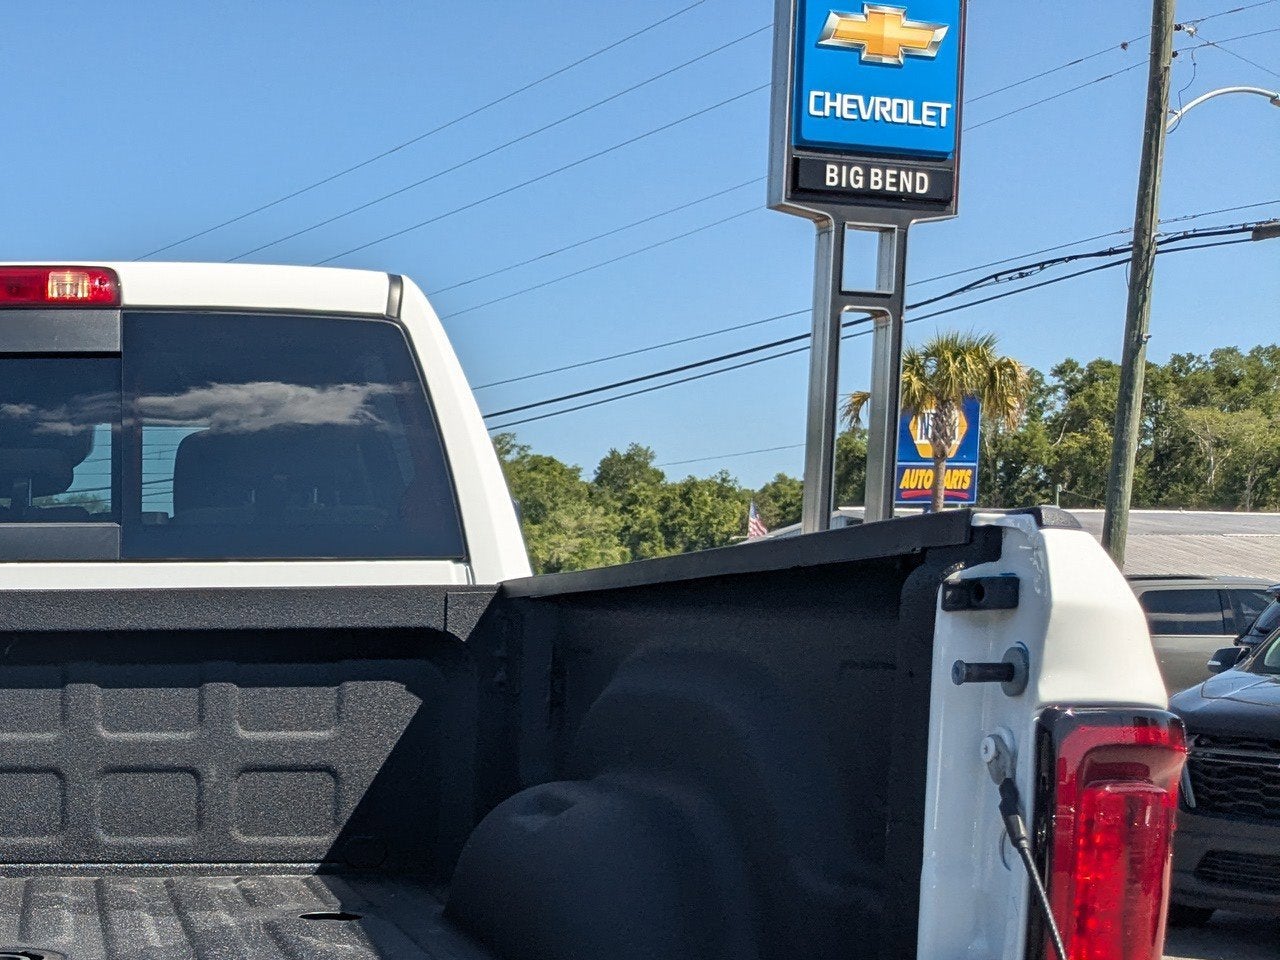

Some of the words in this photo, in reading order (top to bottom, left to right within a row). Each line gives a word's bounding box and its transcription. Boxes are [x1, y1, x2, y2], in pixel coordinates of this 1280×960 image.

[808, 90, 951, 128] CHEVROLET
[825, 164, 864, 189] BIG
[870, 168, 929, 194] BEND
[899, 468, 934, 490] AUTO
[940, 468, 972, 490] ARTS
